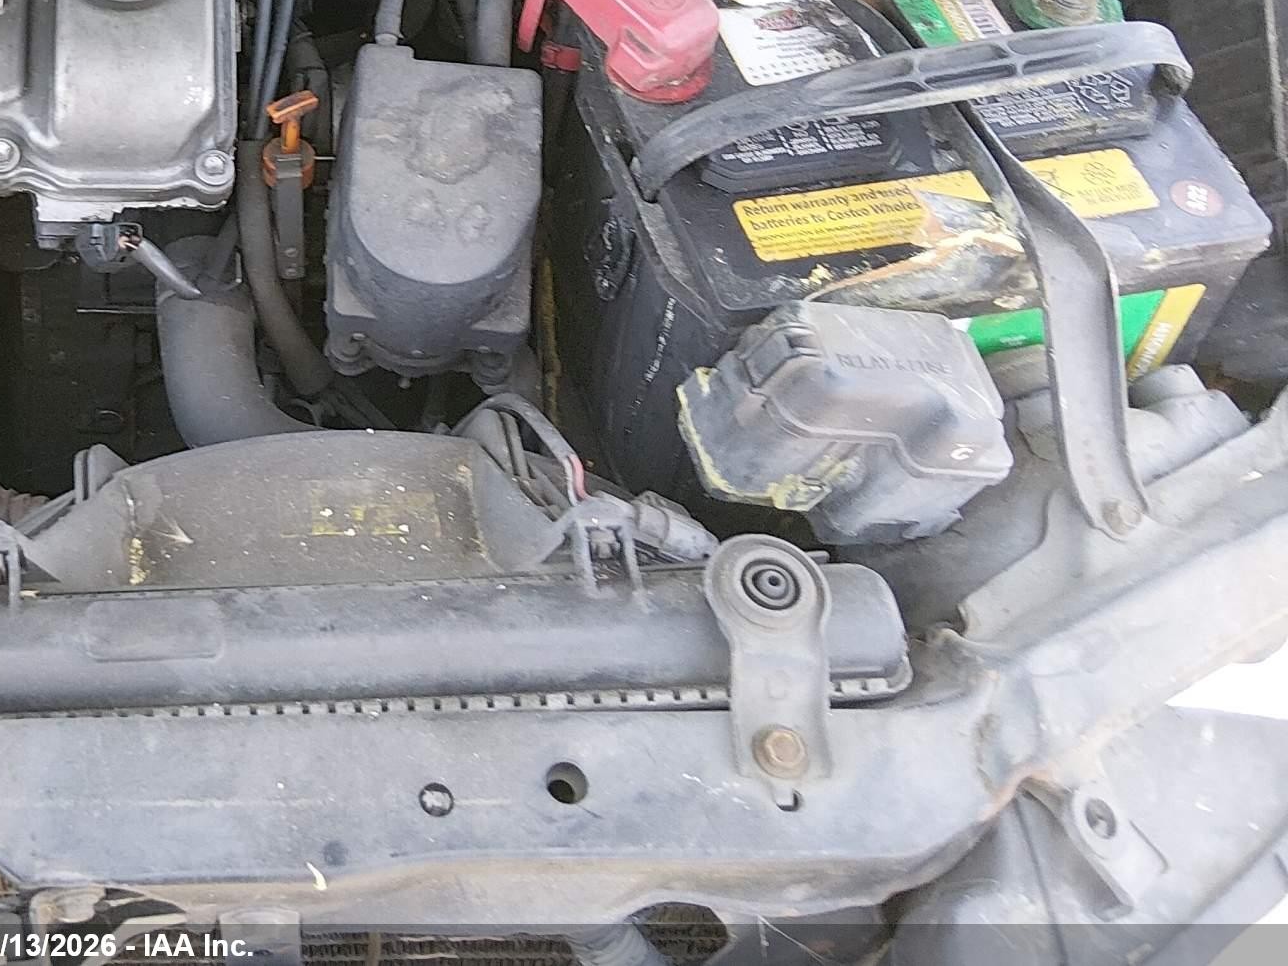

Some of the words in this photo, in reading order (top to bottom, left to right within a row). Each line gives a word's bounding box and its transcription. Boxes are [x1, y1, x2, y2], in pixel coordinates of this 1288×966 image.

[743, 203, 788, 217] Return
[790, 194, 851, 211] warranty
[853, 189, 879, 203] and
[751, 215, 809, 231] batteries
[813, 213, 825, 223] to
[828, 207, 870, 221] Costco
